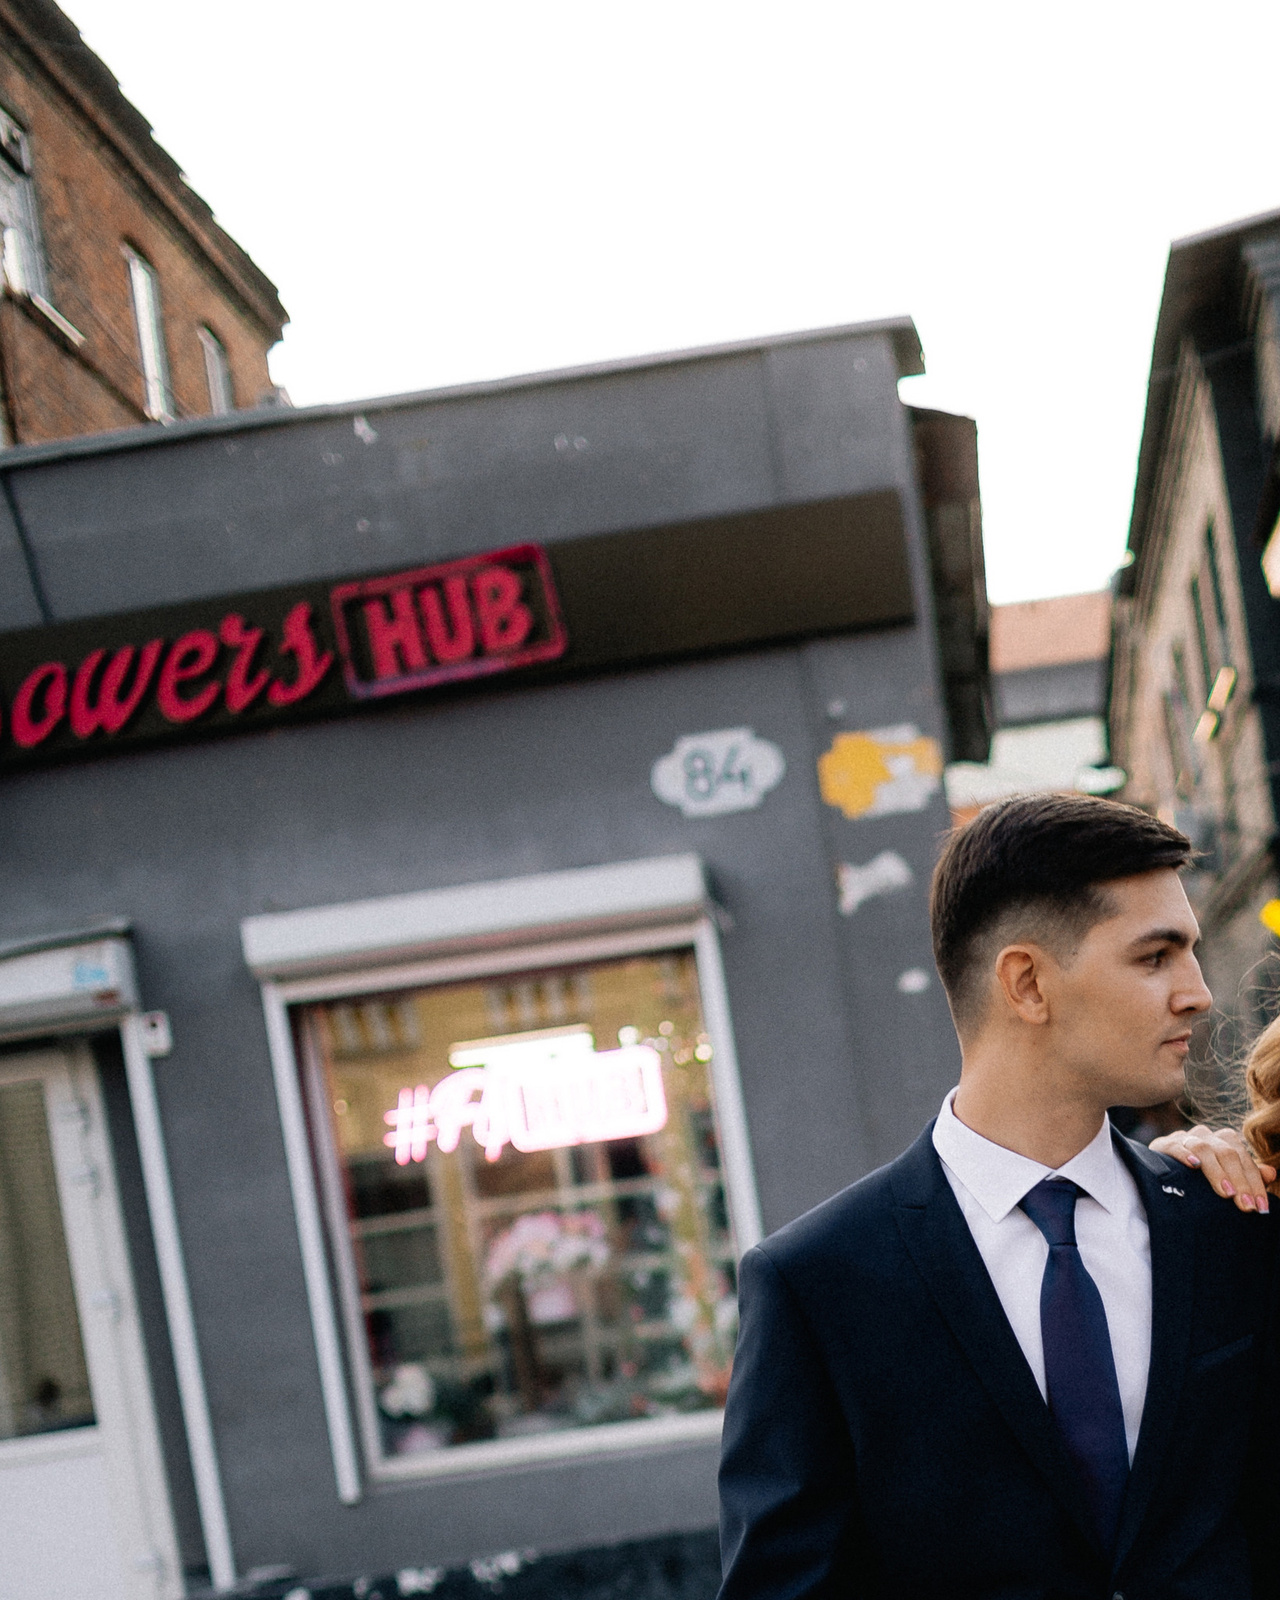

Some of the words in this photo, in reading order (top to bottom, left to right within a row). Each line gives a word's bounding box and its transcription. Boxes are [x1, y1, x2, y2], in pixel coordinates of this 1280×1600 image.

[0, 601, 334, 748] owers
[364, 566, 533, 680] HUB
[683, 745, 753, 801] 84
